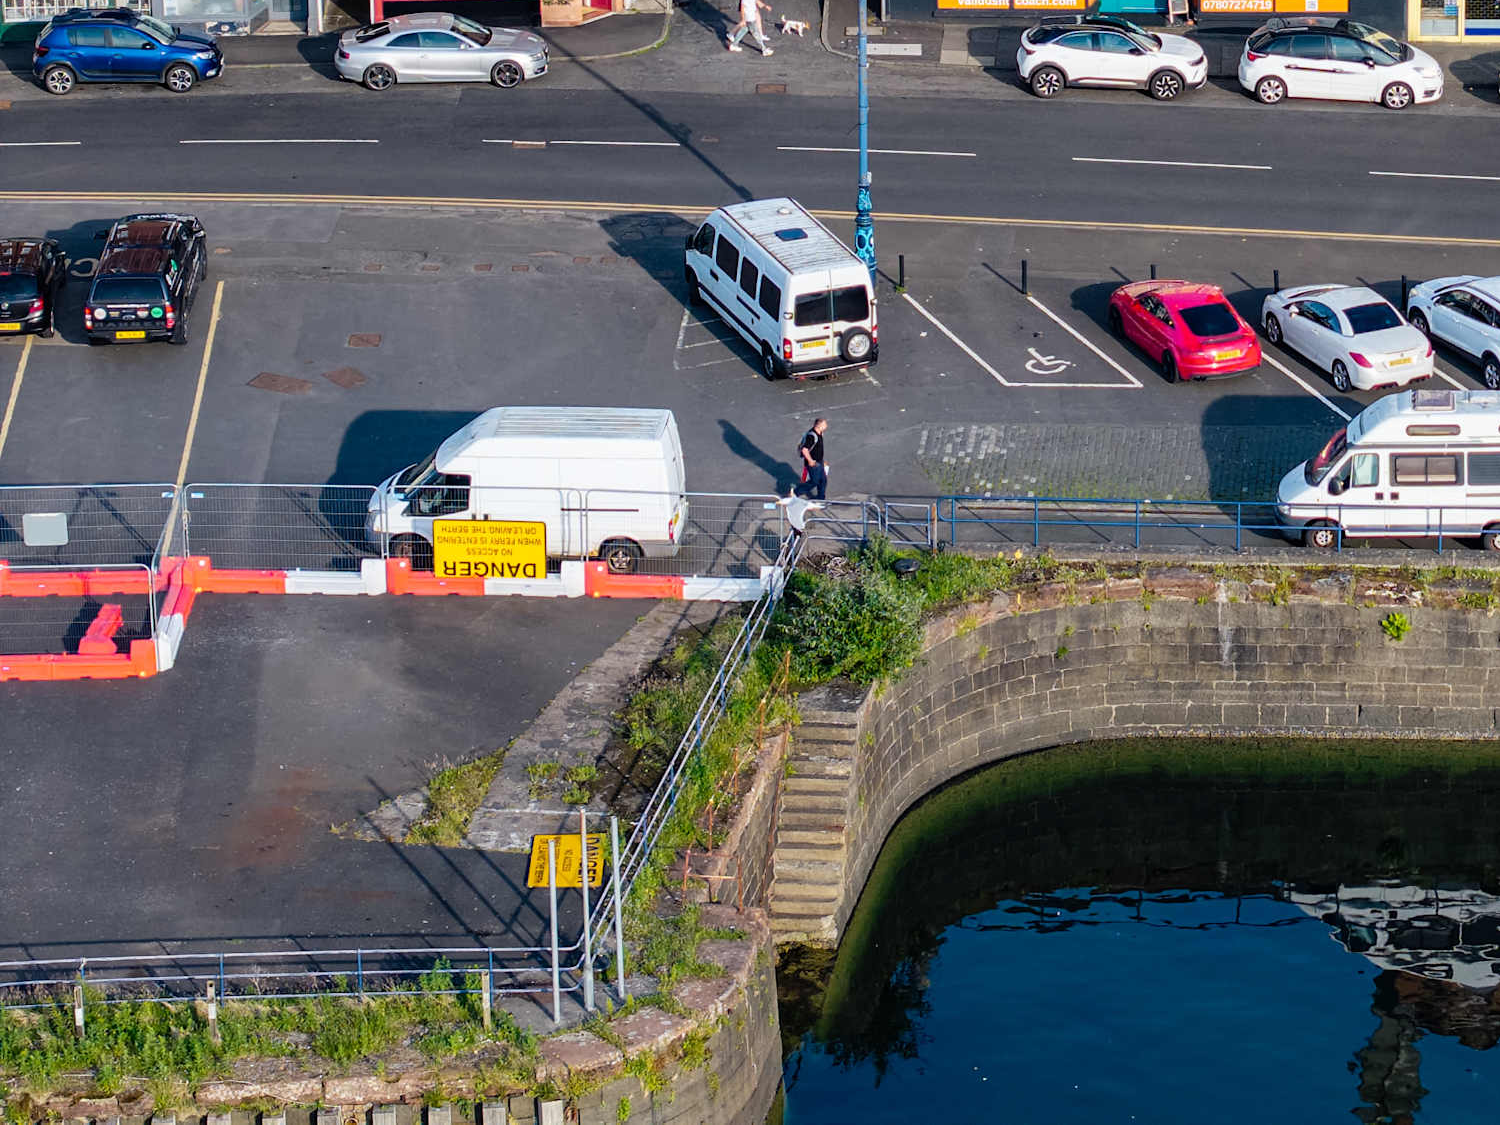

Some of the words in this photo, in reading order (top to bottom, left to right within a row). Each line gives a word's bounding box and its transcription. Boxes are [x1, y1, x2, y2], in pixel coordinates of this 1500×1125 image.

[441, 525, 469, 534] BERTH
[472, 525, 486, 534] THE
[489, 526, 522, 535] LEAVING
[525, 527, 537, 535] OR
[437, 535, 478, 544] ENTERING
[480, 536, 488, 544] IS
[490, 537, 515, 546] FERRY
[517, 538, 543, 546] WHEN
[466, 547, 498, 556] ACCESS
[501, 548, 513, 556] NO
[443, 561, 537, 578] DANGER
[577, 837, 600, 884] DANGER
